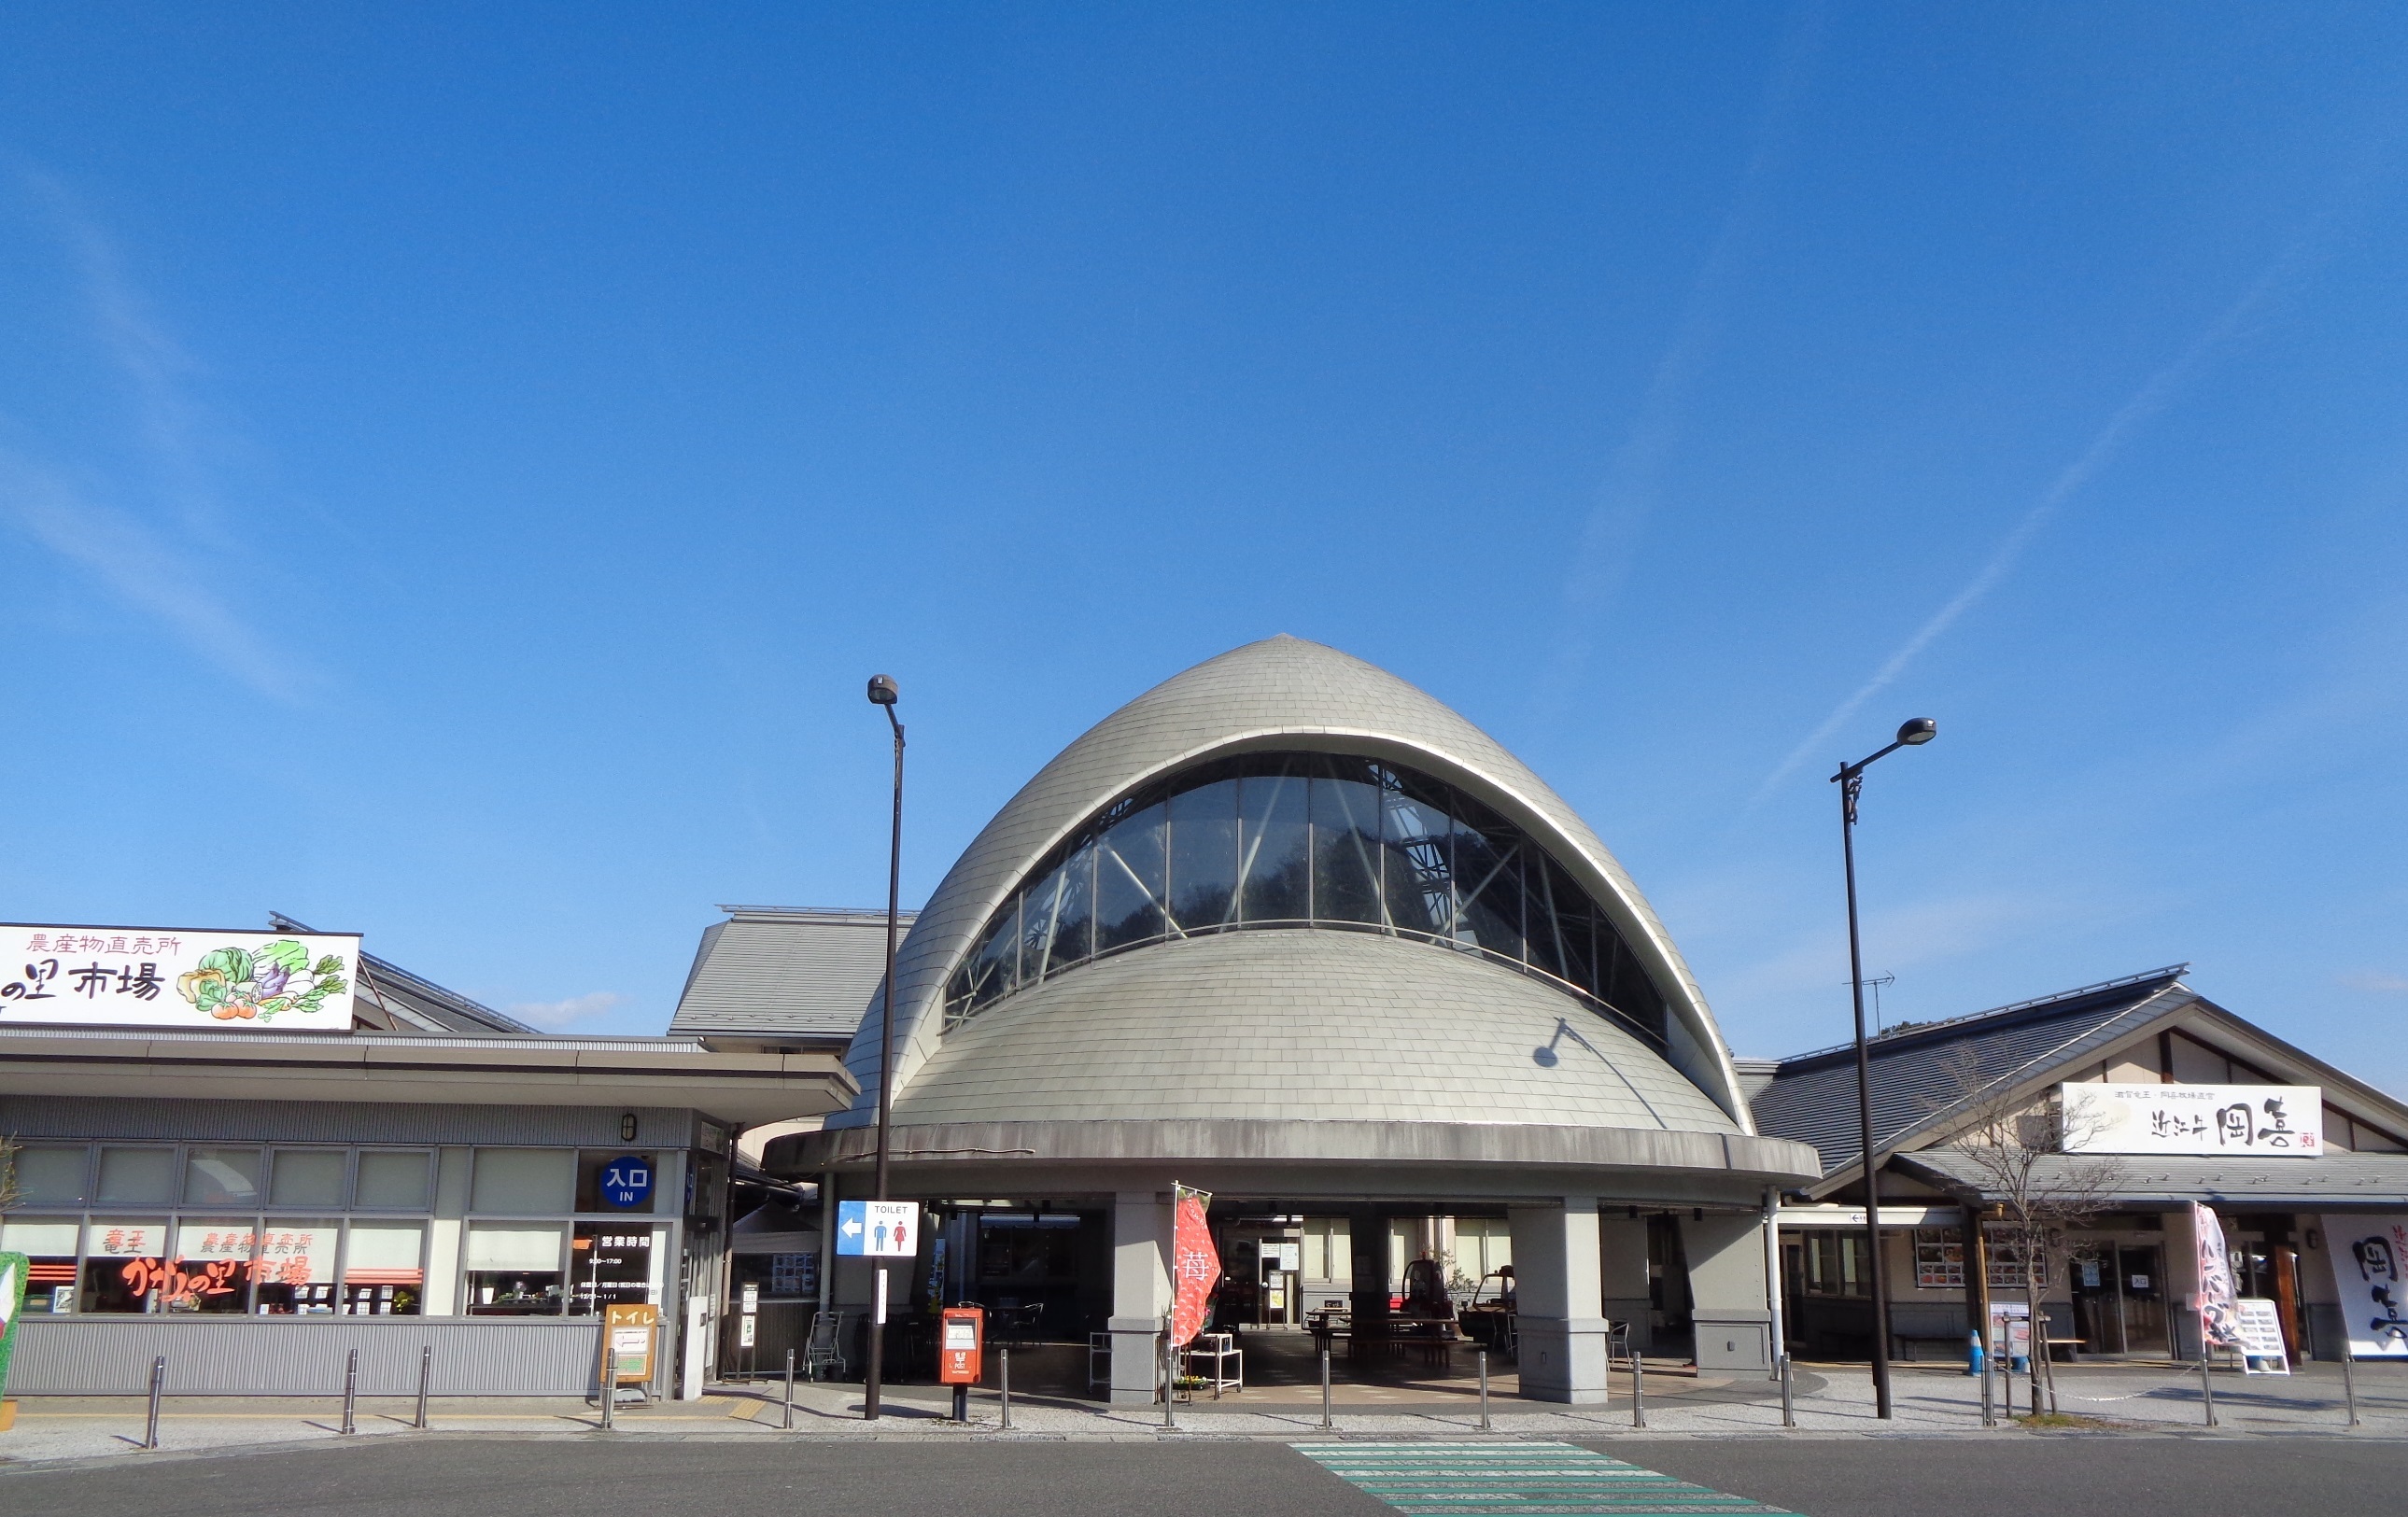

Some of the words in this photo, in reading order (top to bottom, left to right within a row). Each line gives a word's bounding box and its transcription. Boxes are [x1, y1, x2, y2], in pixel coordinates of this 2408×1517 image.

[26, 934, 182, 956] 農産物直売所
[0, 959, 165, 1008] の里市場
[2151, 1109, 2208, 1141] 近江牛
[2217, 1096, 2295, 1147] 岡喜
[606, 1168, 648, 1187] 入口
[619, 1191, 634, 1201] IN
[875, 1205, 908, 1214] TOILET
[107, 1229, 146, 1247] 竜王
[204, 1231, 314, 1247] 農産物直売所
[602, 1236, 650, 1247] 営業時間
[1183, 1251, 1209, 1281] 苺
[612, 1310, 655, 1325] トイレ
